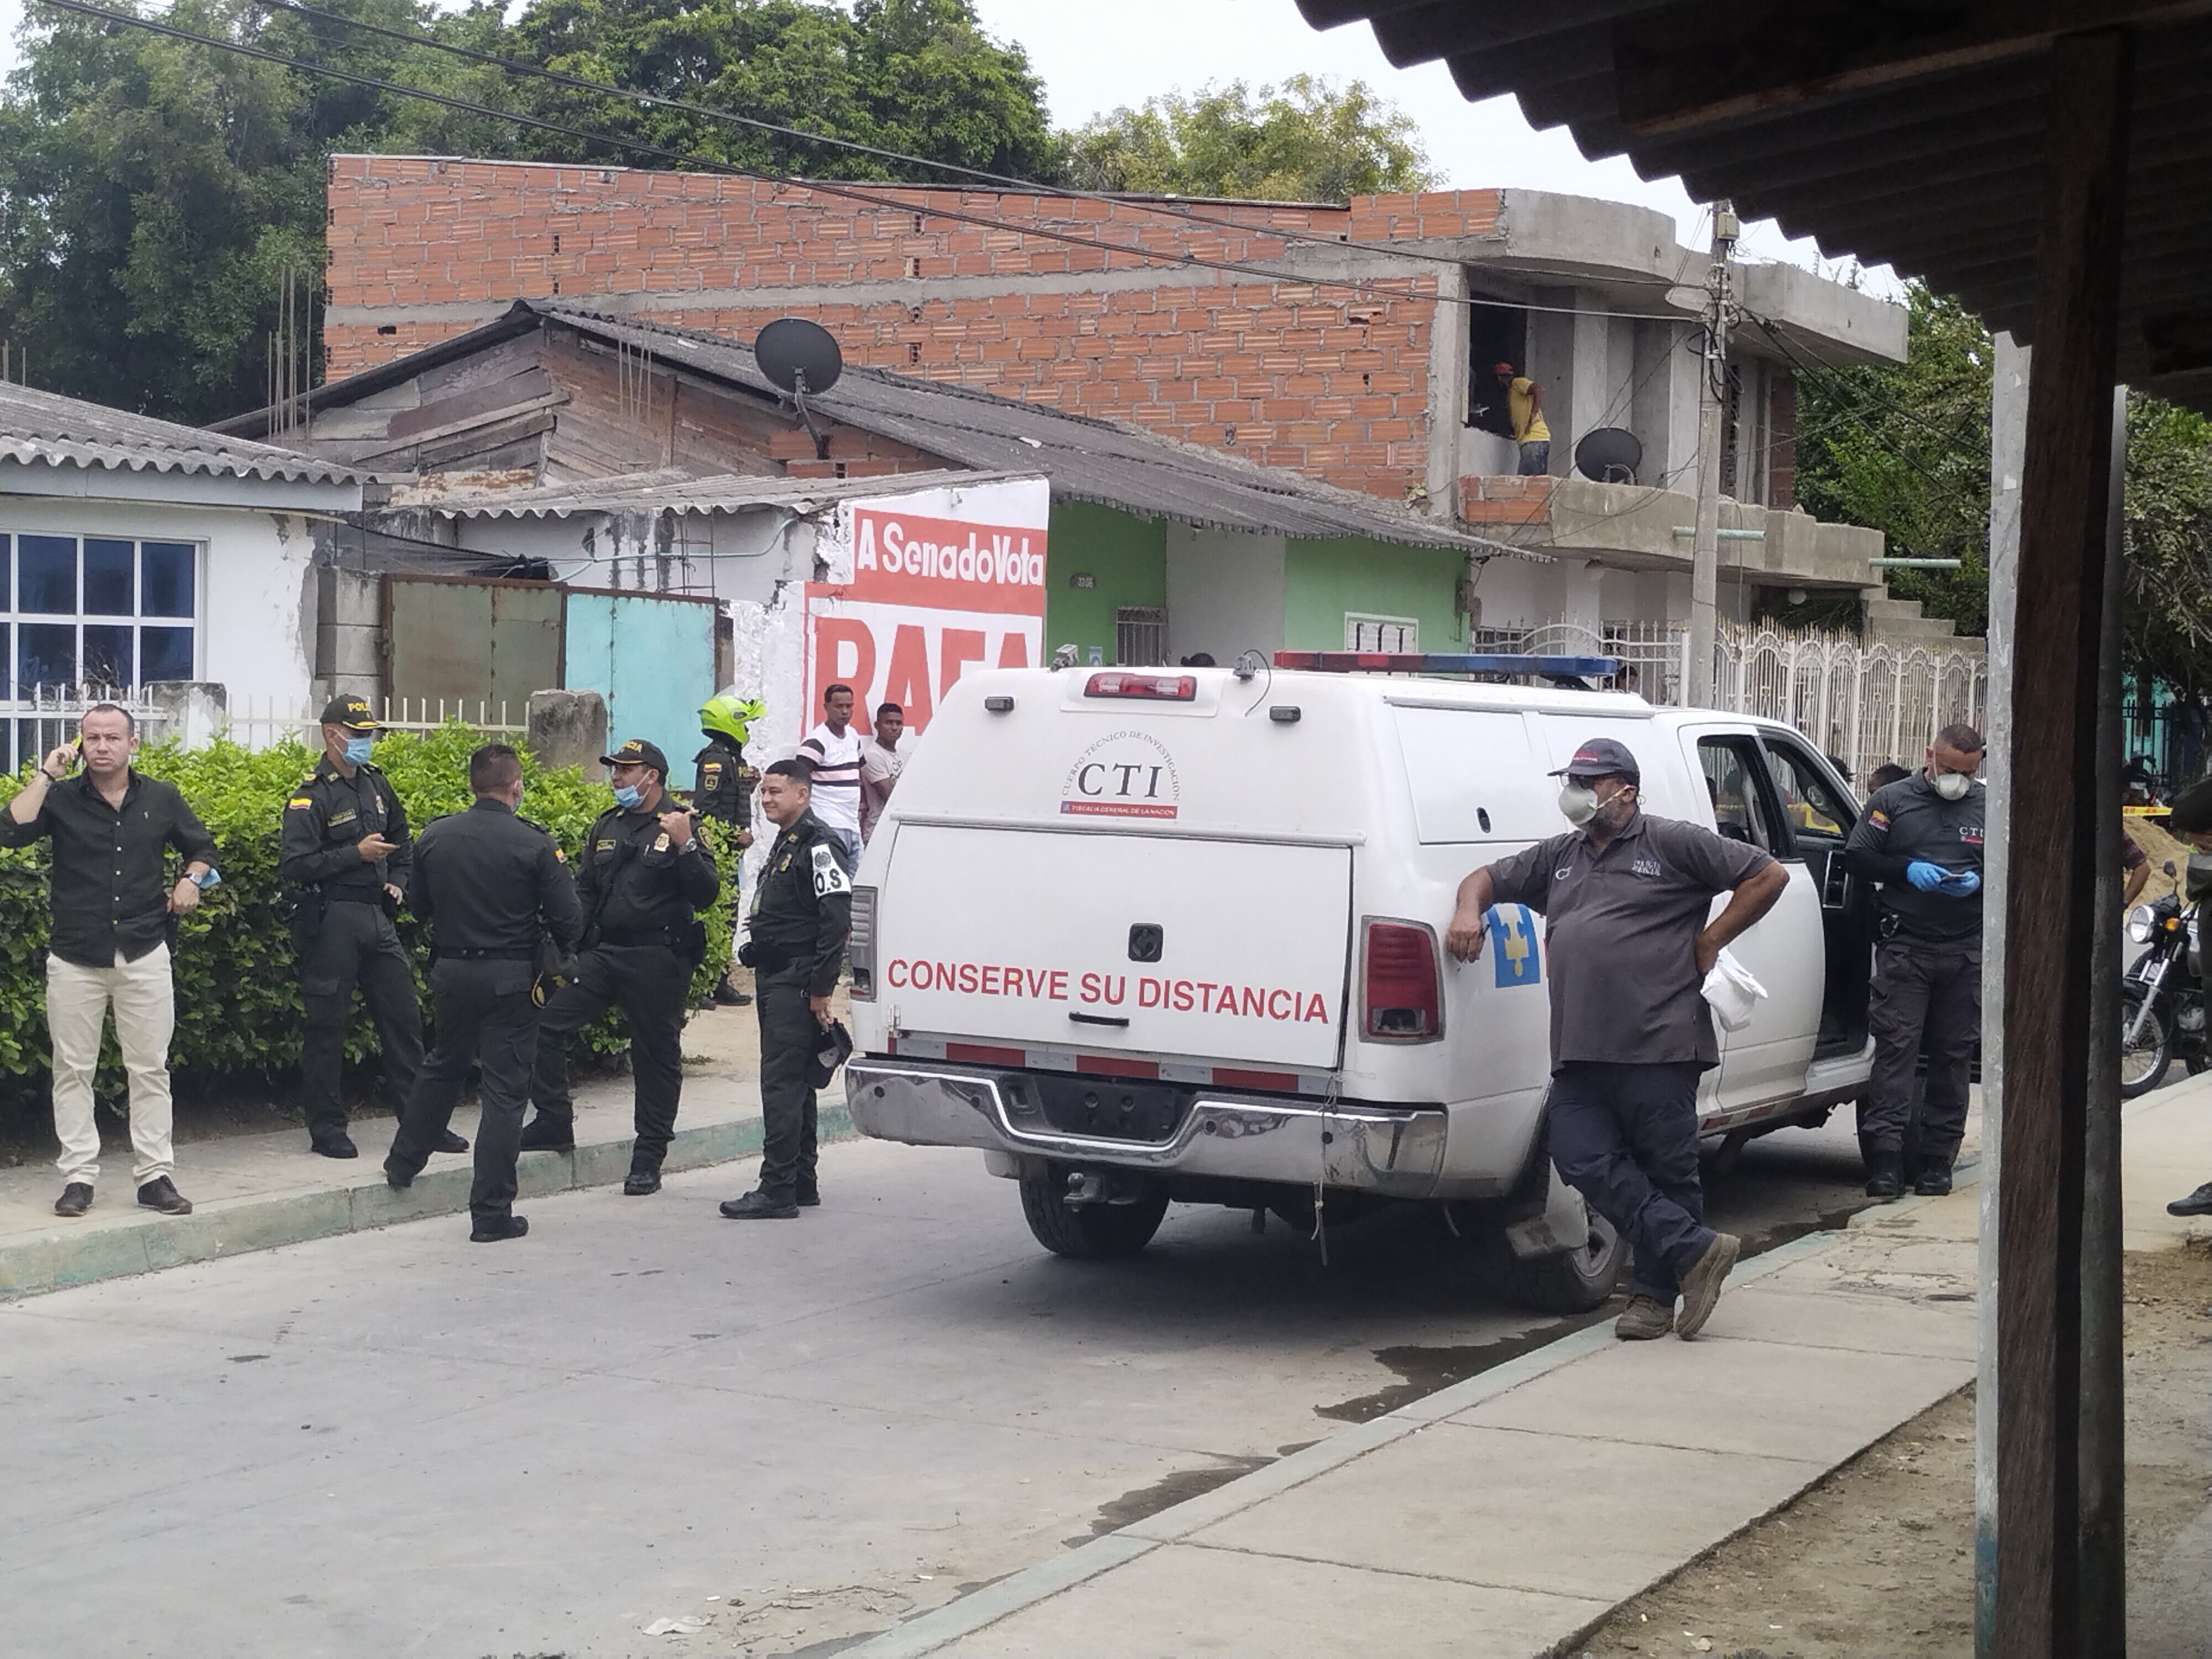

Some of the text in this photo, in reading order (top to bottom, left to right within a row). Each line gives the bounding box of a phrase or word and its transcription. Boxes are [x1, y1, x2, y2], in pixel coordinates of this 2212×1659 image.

[857, 518, 1044, 586] A Senado Vota
[1062, 757, 1085, 796] CUERPO
[1129, 731, 1143, 739] DE
[1078, 763, 1164, 798] CTI
[1959, 827, 1984, 838] CTI
[888, 958, 1329, 1025] CONSERVE SU DISTANCIA
